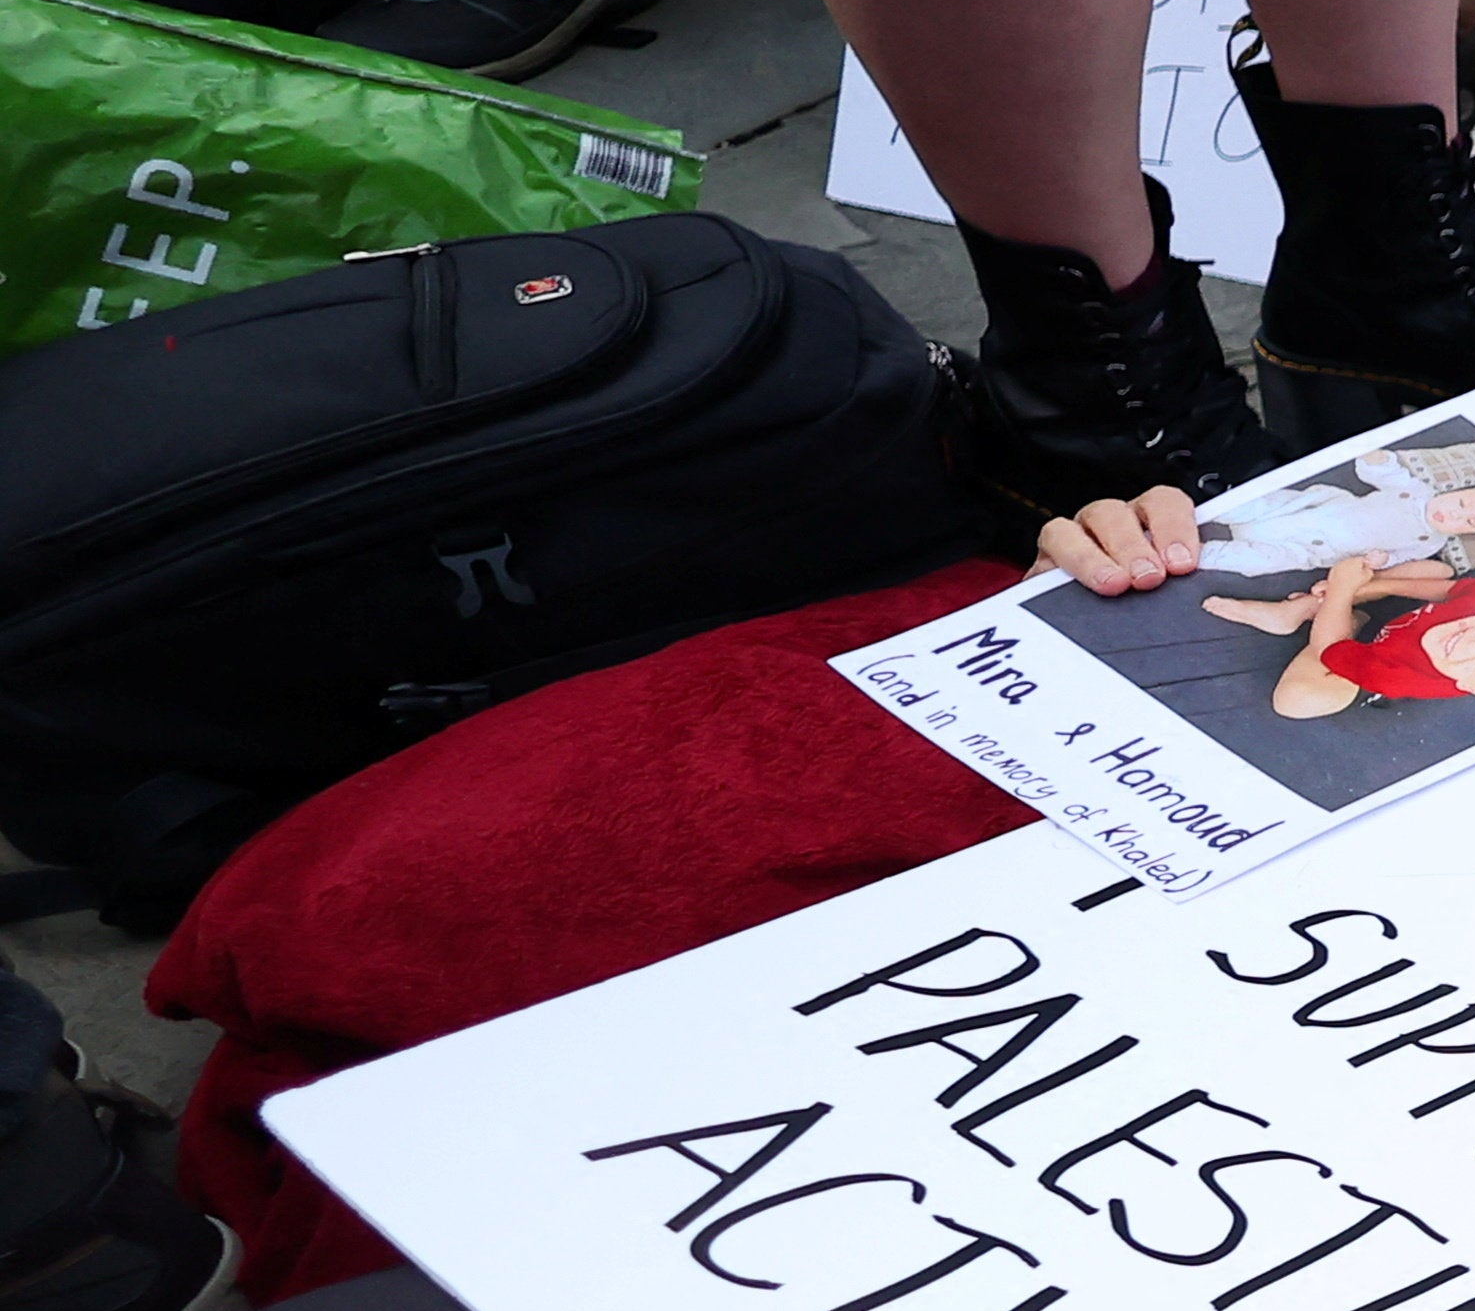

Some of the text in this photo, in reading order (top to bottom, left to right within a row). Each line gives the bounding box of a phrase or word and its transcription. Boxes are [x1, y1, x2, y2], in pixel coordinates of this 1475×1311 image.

[932, 626, 1038, 705] Mira
[857, 654, 939, 707] (and
[926, 706, 957, 730] in
[961, 733, 1058, 800] memory
[1064, 803, 1107, 823] of
